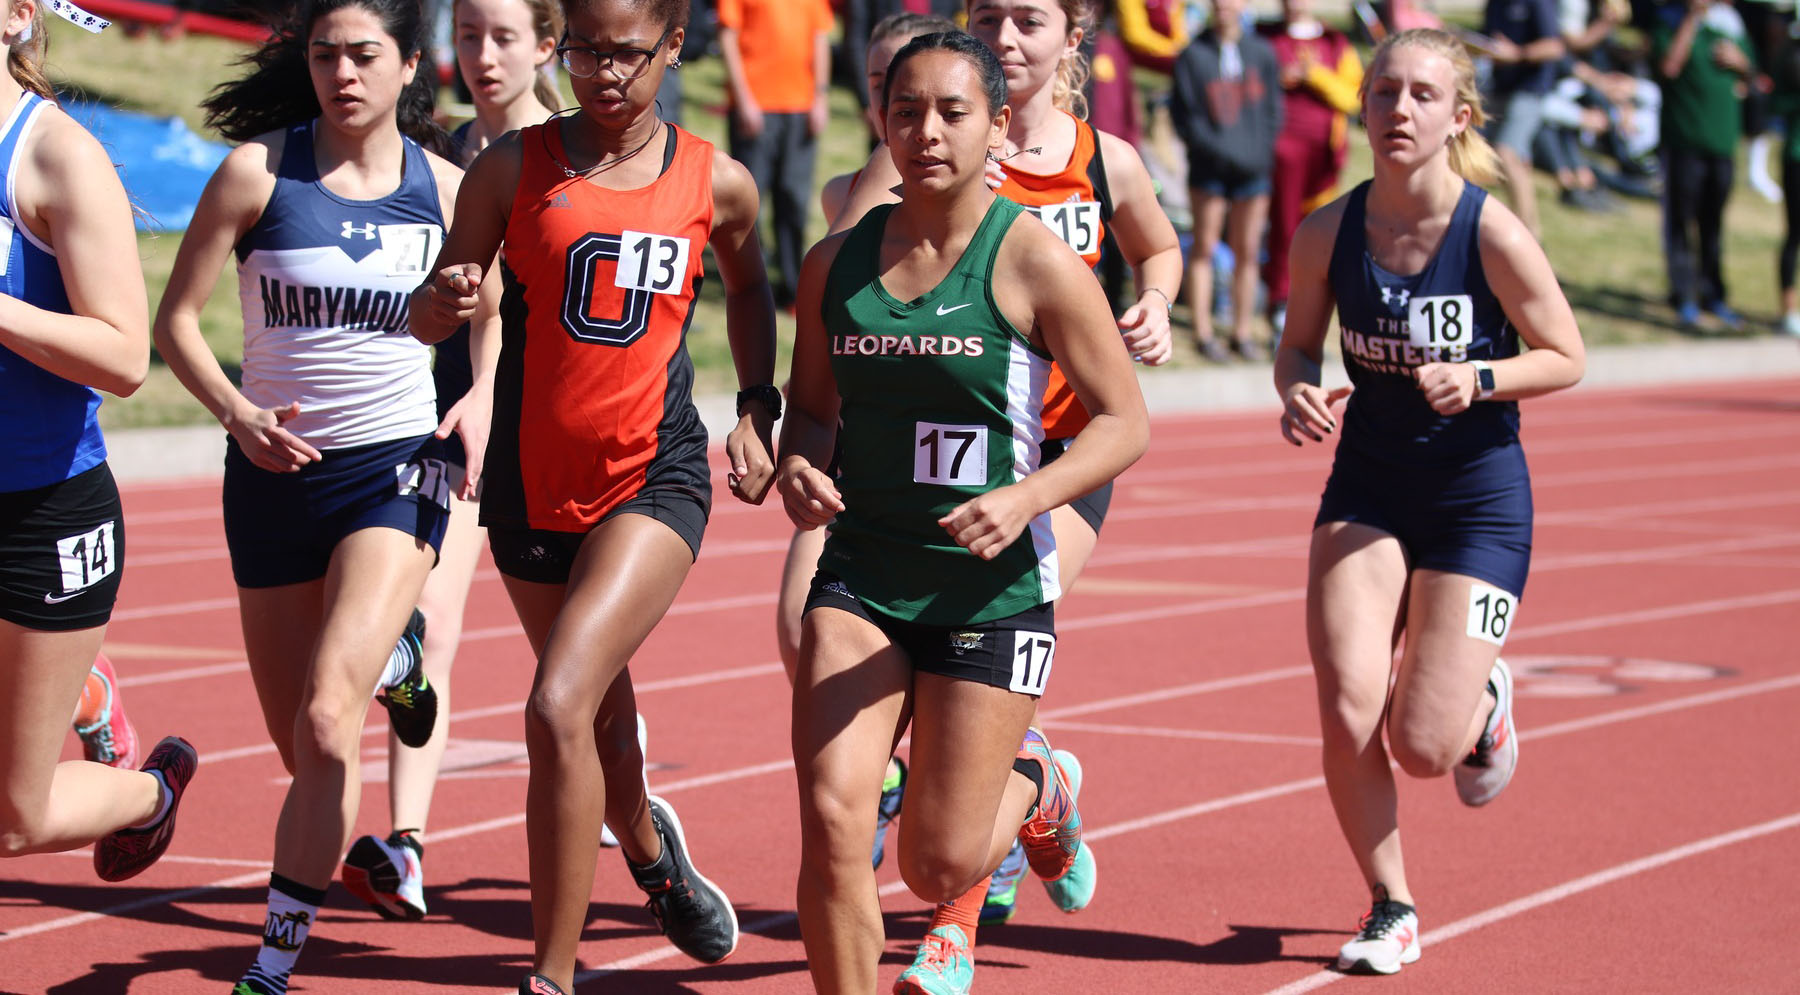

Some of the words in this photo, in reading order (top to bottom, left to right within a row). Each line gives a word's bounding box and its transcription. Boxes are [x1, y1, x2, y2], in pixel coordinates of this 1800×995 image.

[1053, 205, 1091, 252] 15
[633, 236, 679, 291] 13
[259, 274, 411, 334] MARYMOU
[1376, 317, 1410, 335] THE
[1420, 299, 1463, 344] 18
[832, 334, 985, 358] LEOPARDS
[1341, 324, 1468, 366] MASTERS
[919, 428, 977, 480] 17
[72, 528, 108, 585] 14
[1475, 593, 1510, 639] 18
[1018, 637, 1053, 689] 17
